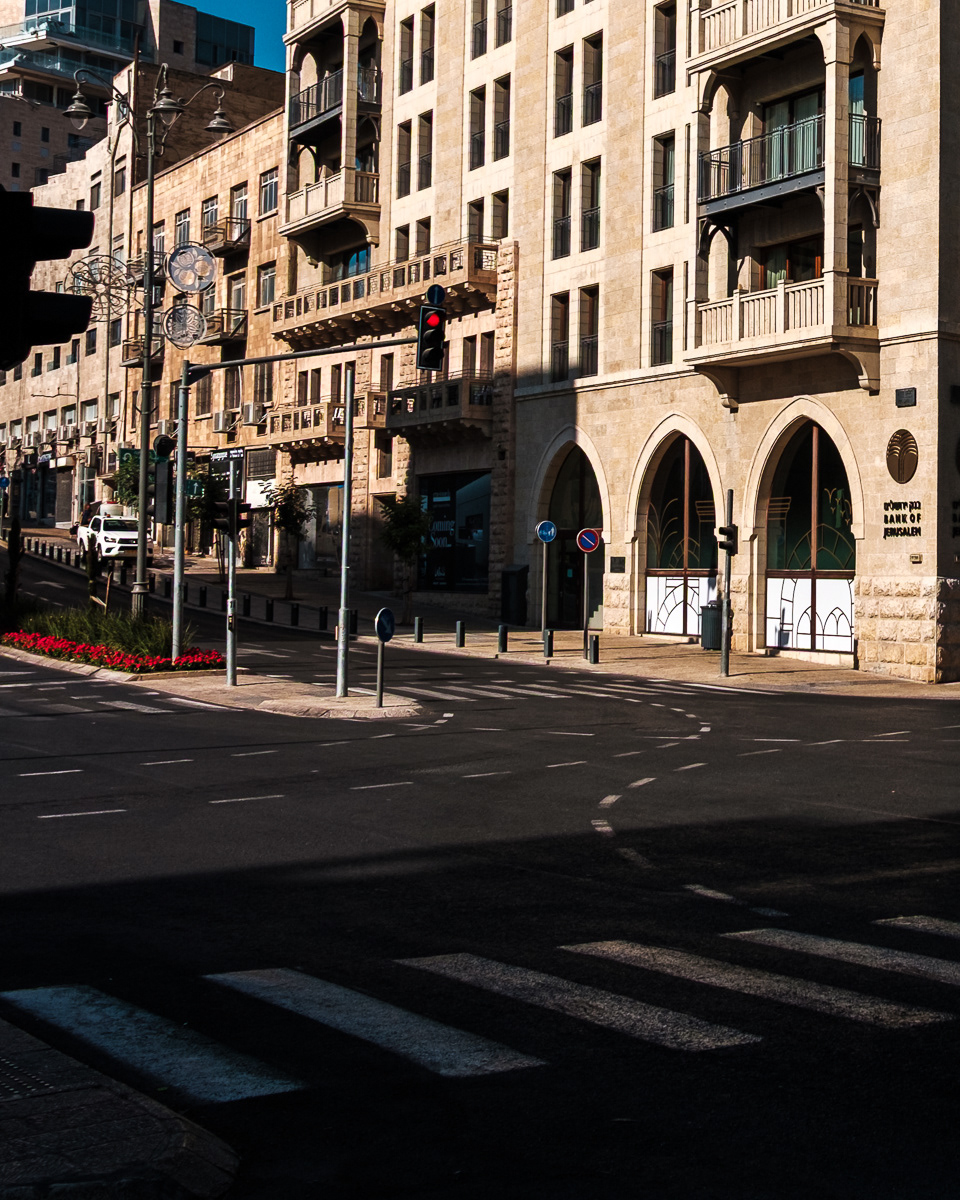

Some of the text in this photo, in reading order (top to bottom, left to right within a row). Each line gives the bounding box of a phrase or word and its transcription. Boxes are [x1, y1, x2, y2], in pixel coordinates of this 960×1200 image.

[884, 500, 921, 512] בנק ירושלים
[884, 513, 922, 524] BANK OF
[883, 527, 922, 540] JERUSALEM
